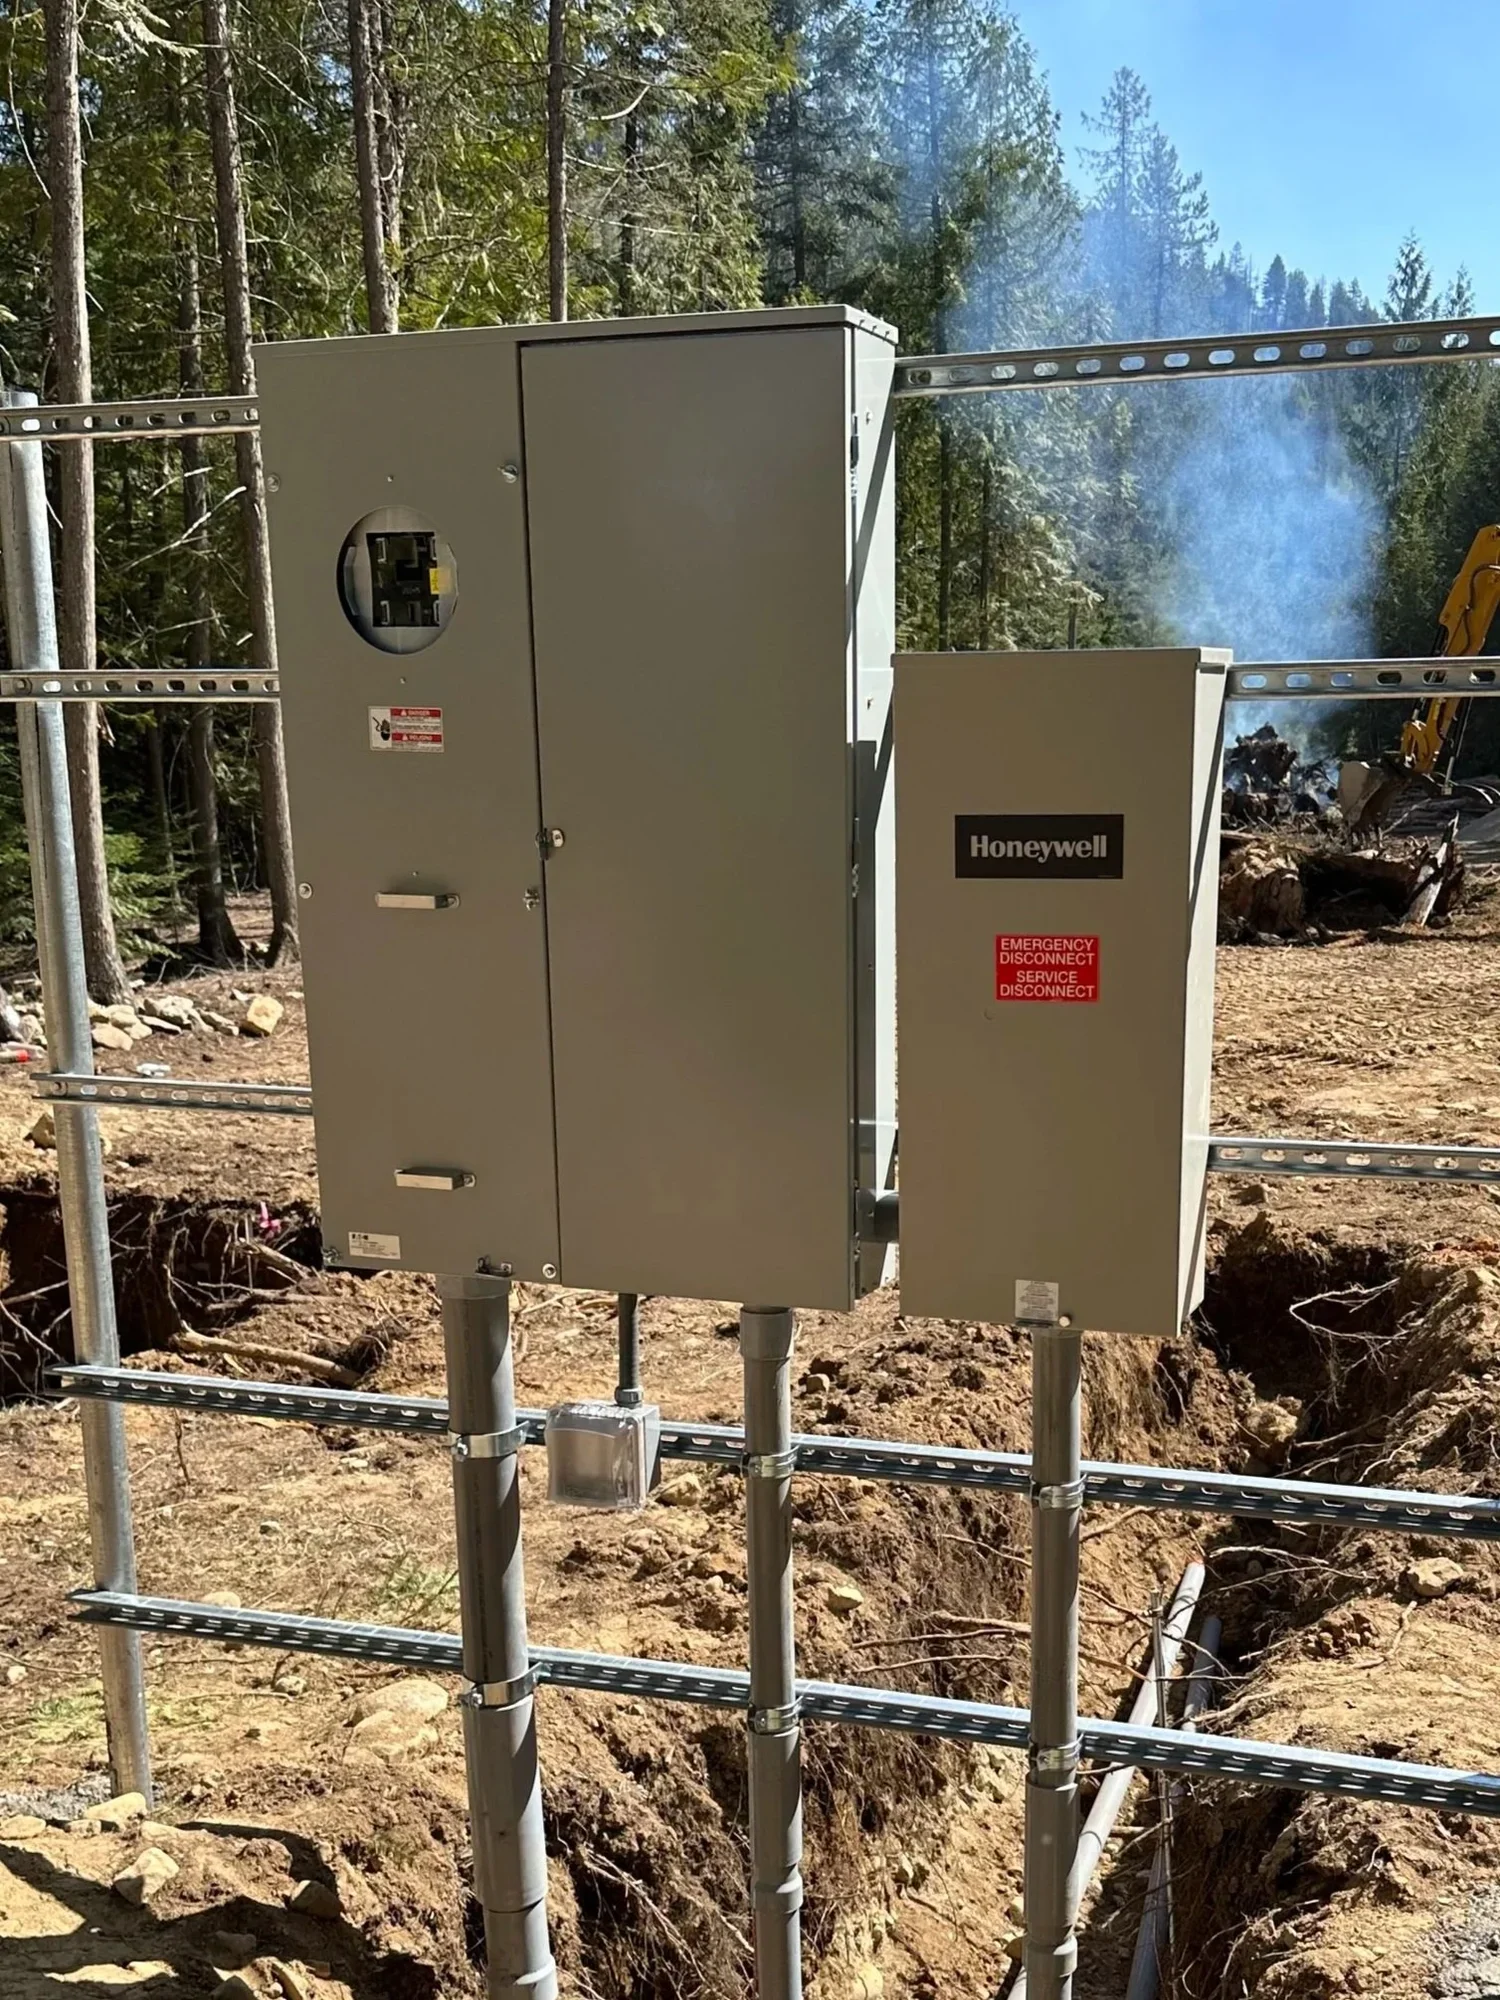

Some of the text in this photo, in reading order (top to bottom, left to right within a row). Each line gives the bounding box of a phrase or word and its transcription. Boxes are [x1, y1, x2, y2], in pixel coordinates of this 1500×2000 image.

[970, 835, 1107, 863] Honeywell
[1000, 938, 1094, 951] EMERGENCY
[1000, 952, 1095, 966] DISCONNECT
[1016, 970, 1078, 984] SERVICE
[1000, 985, 1095, 998] DISCONNECT
